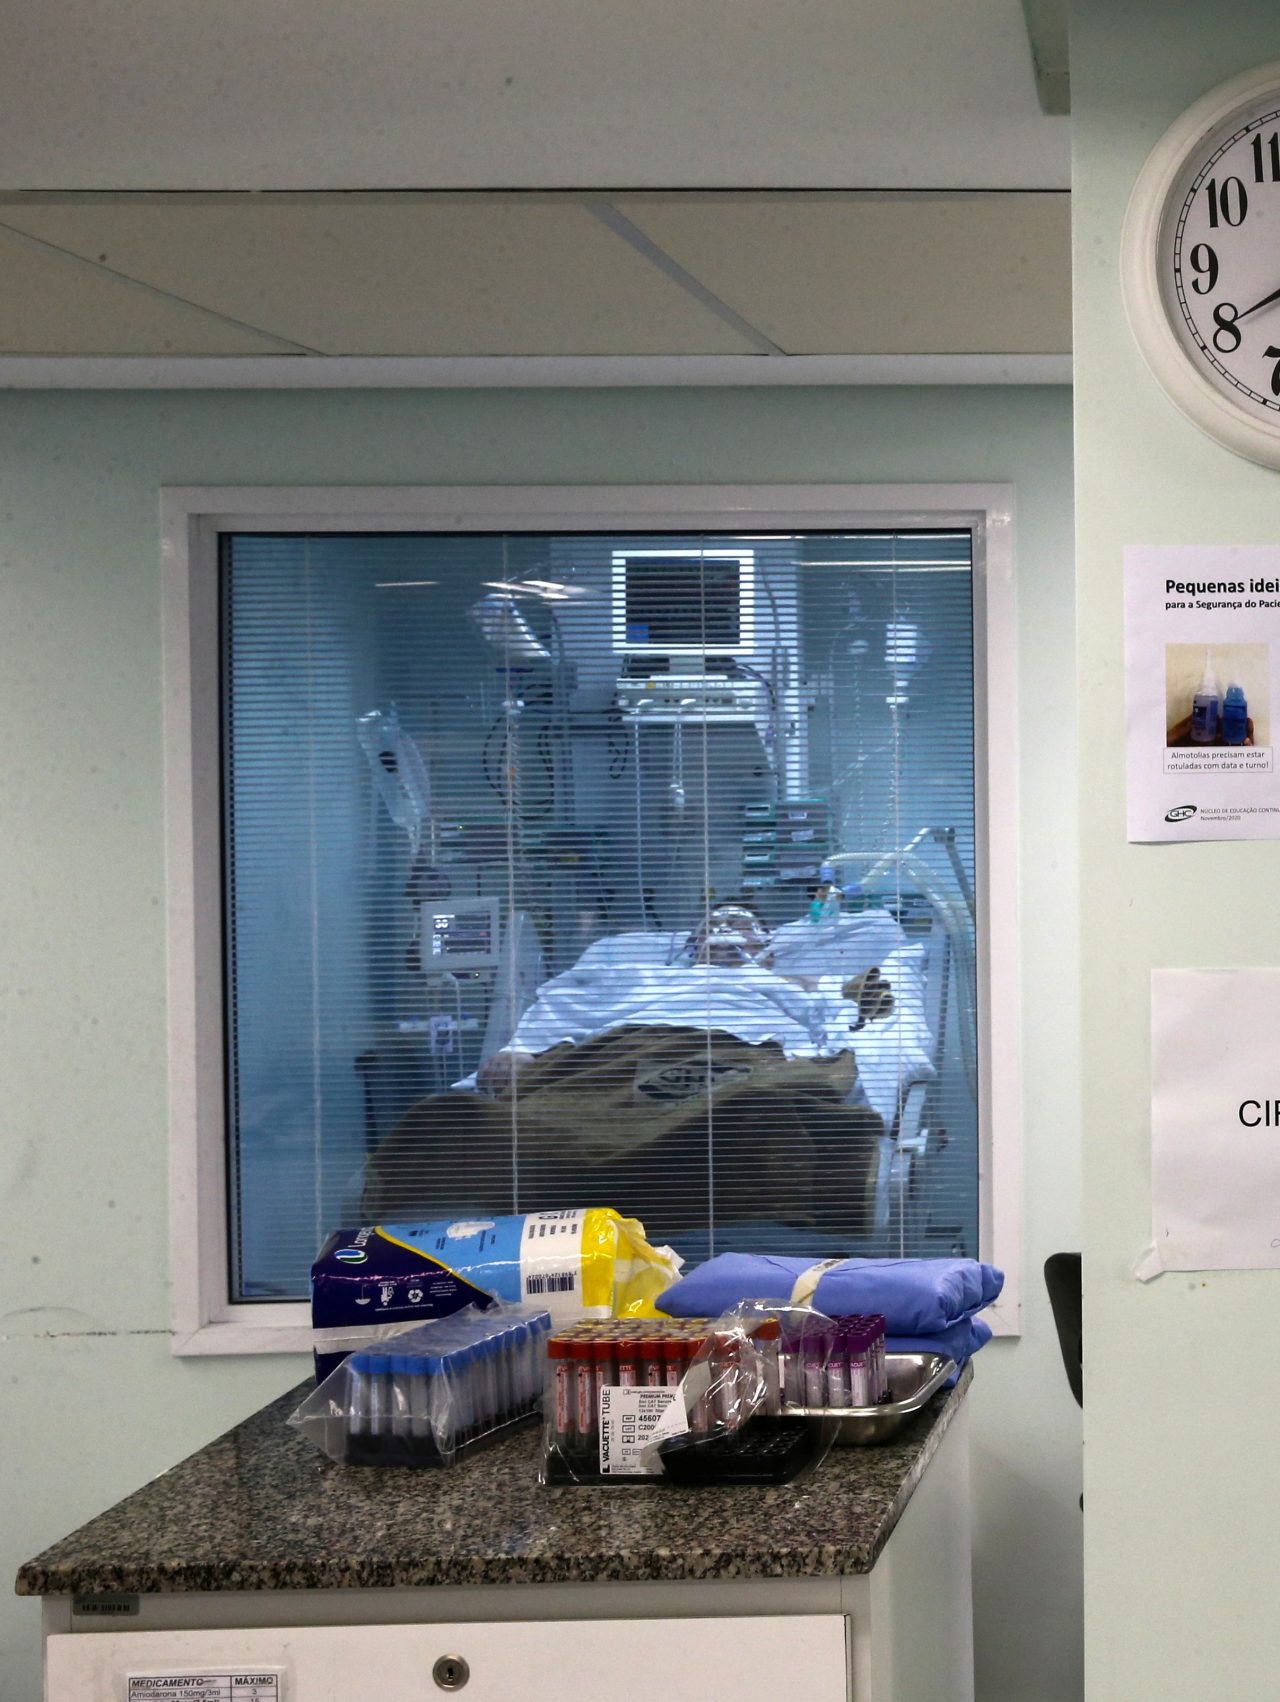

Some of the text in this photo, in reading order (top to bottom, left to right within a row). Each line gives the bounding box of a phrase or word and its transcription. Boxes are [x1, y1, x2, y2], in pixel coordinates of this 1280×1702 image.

[1204, 175, 1249, 228] 10
[1189, 242, 1220, 295] 9
[1211, 301, 1242, 353] 8
[1165, 579, 1245, 597] Pequenas
[1165, 602, 1186, 610] para
[1195, 600, 1242, 611] Segurança
[1244, 599, 1257, 608] do
[1171, 751, 1265, 760] Almotolias precisam estar
[1167, 761, 1202, 770] rotuladas
[1220, 761, 1238, 770] data
[1245, 761, 1269, 770] turno!
[602, 1389, 611, 1416] TUBE
[638, 1414, 662, 1422] 45607
[131, 1675, 274, 1688] MEDICAMENTO MÁXIMO
[130, 1688, 177, 1698] Amiodarona
[179, 1687, 221, 1699] 150mg/3ml
